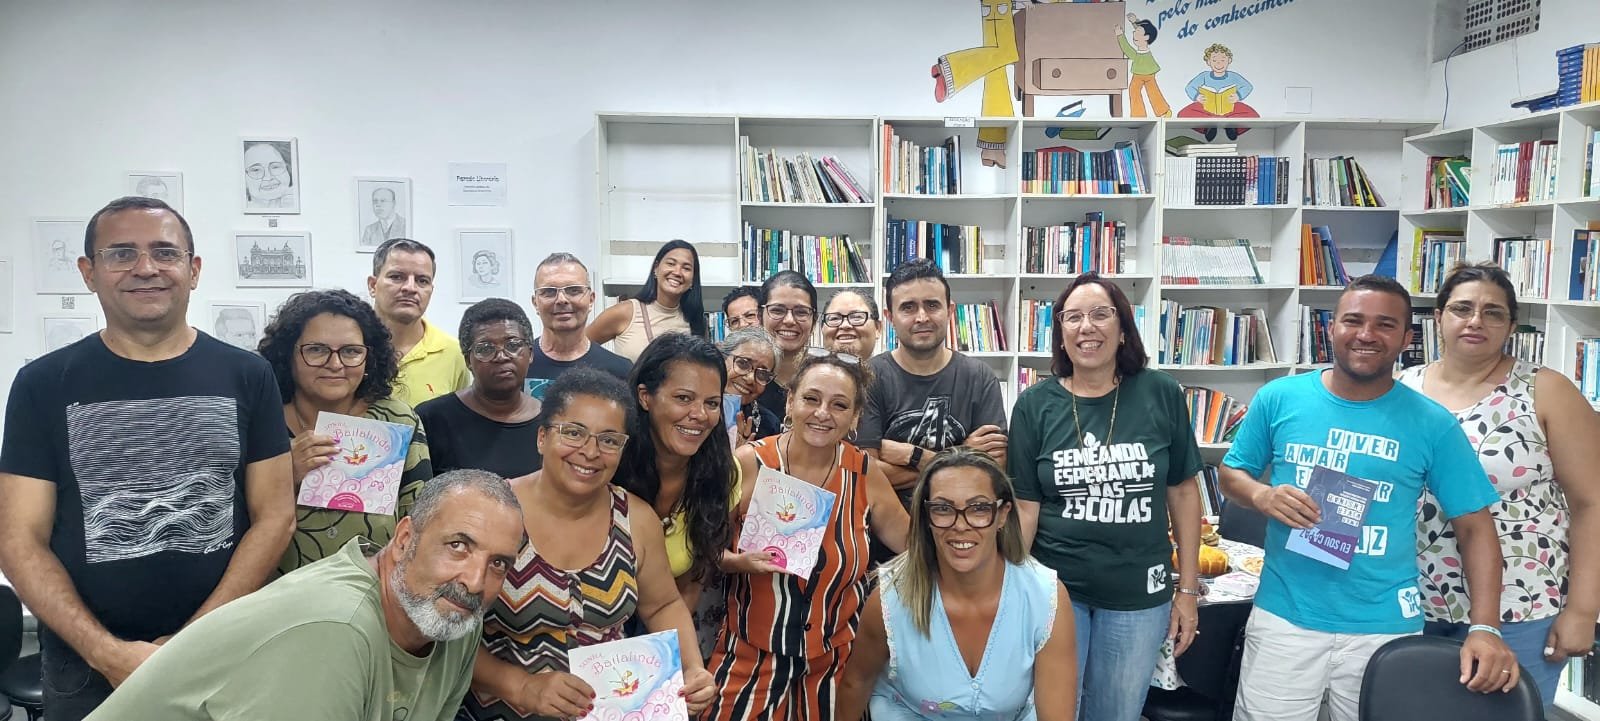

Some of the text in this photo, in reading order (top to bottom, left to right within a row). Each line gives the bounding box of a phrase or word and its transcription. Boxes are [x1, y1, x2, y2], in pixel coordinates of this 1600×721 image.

[1158, 0, 1190, 30] pelo
[1177, 20, 1198, 39] do
[1053, 443, 1148, 467] SEMEANDO
[1329, 430, 1398, 459] VIVER
[1286, 445, 1347, 470] AMAR
[1054, 462, 1153, 485] ESPERANÇA
[1088, 481, 1125, 498] NAS
[1062, 496, 1152, 523] ESCOLAS
[1324, 537, 1340, 550] SOU
[1339, 542, 1351, 554] EU
